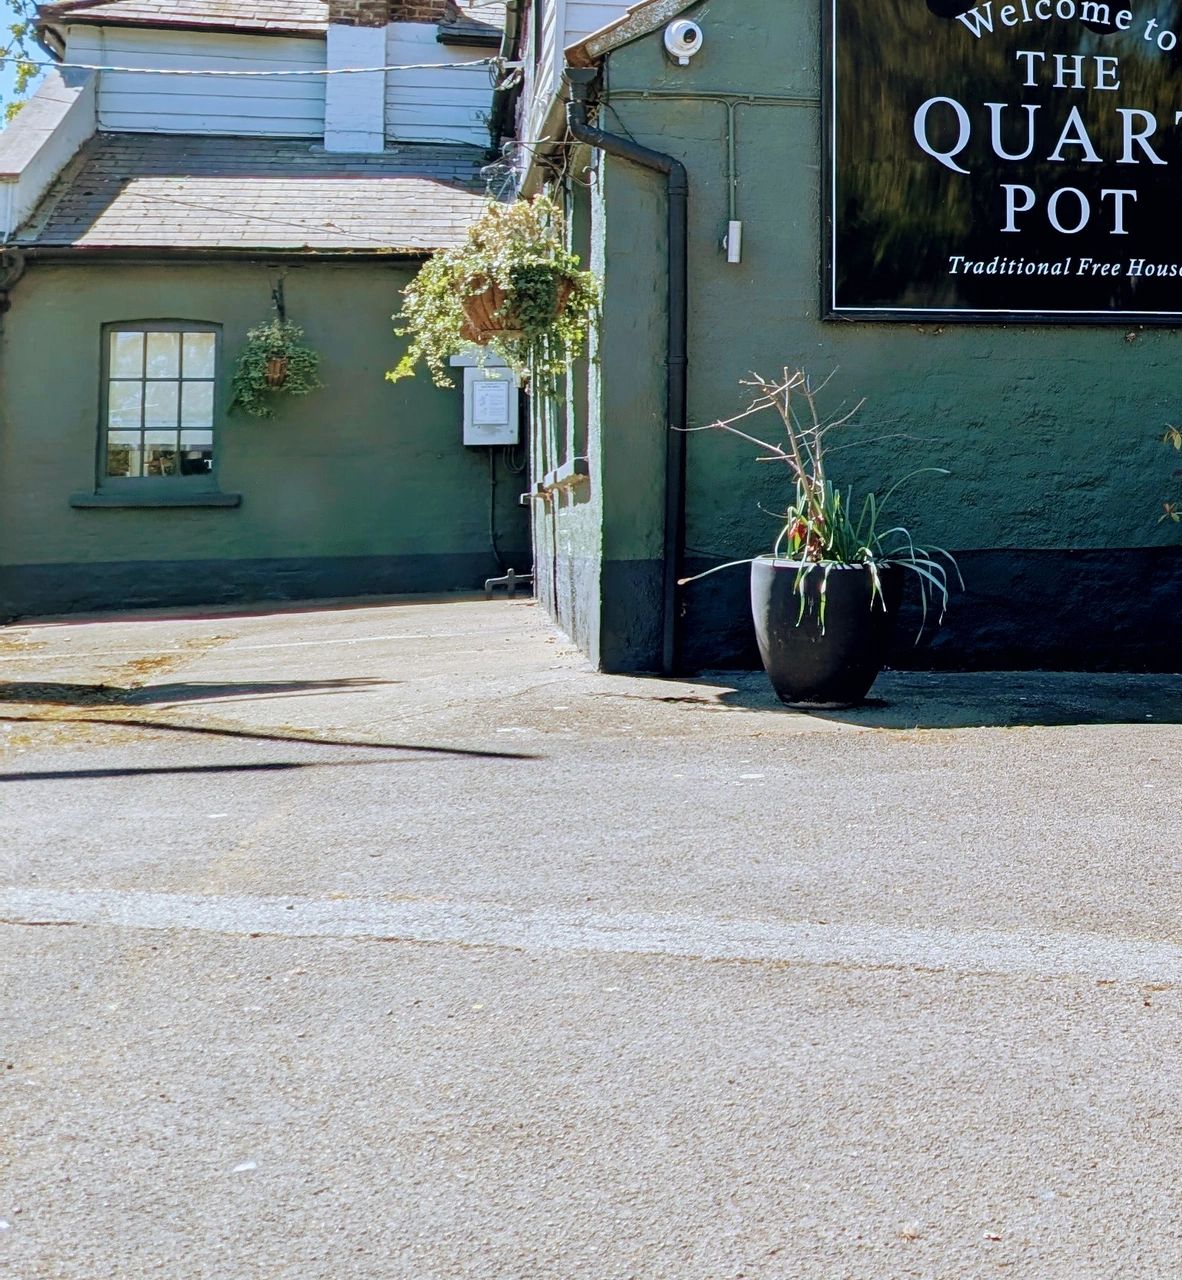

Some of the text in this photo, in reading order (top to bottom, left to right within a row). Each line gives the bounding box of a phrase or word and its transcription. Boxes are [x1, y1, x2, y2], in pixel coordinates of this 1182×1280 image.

[1144, 17, 1177, 51] to
[1016, 51, 1121, 91] THE
[1000, 184, 1138, 235] POT
[949, 256, 1072, 277] Traditional
[1076, 258, 1121, 277] Free
